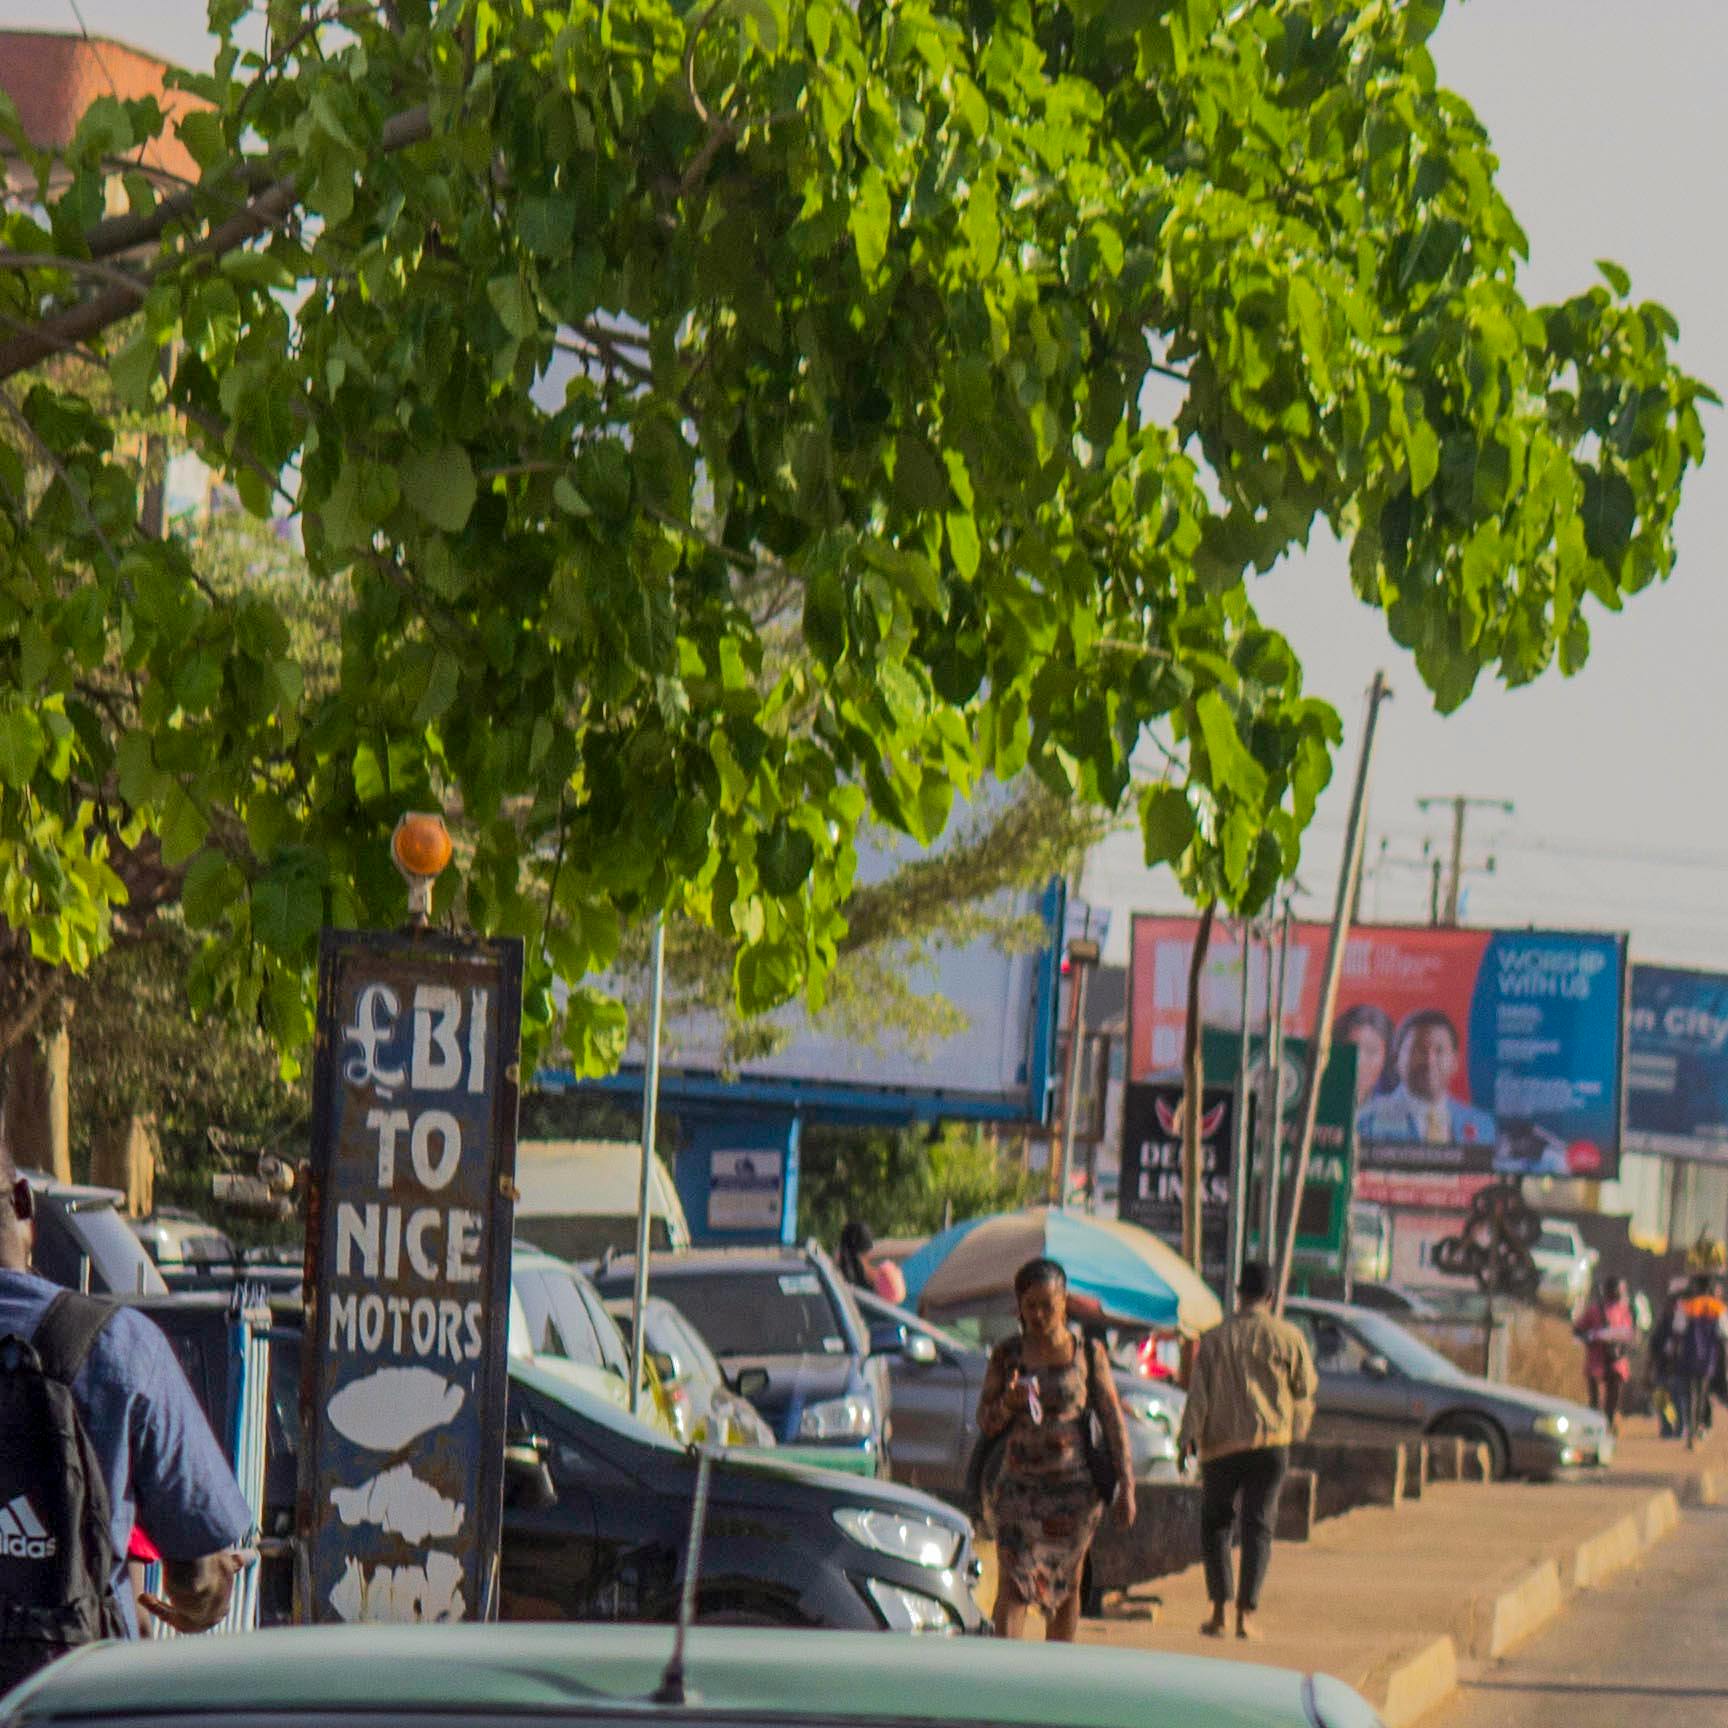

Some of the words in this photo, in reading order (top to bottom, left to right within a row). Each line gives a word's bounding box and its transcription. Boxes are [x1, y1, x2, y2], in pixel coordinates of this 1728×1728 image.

[1499, 974, 1557, 997] WITH
[1560, 977, 1592, 999] US
[366, 1108, 462, 1192] TO
[336, 1203, 485, 1284] NICE
[327, 1296, 485, 1360] MOTORS
[0, 1530, 57, 1559] idas
